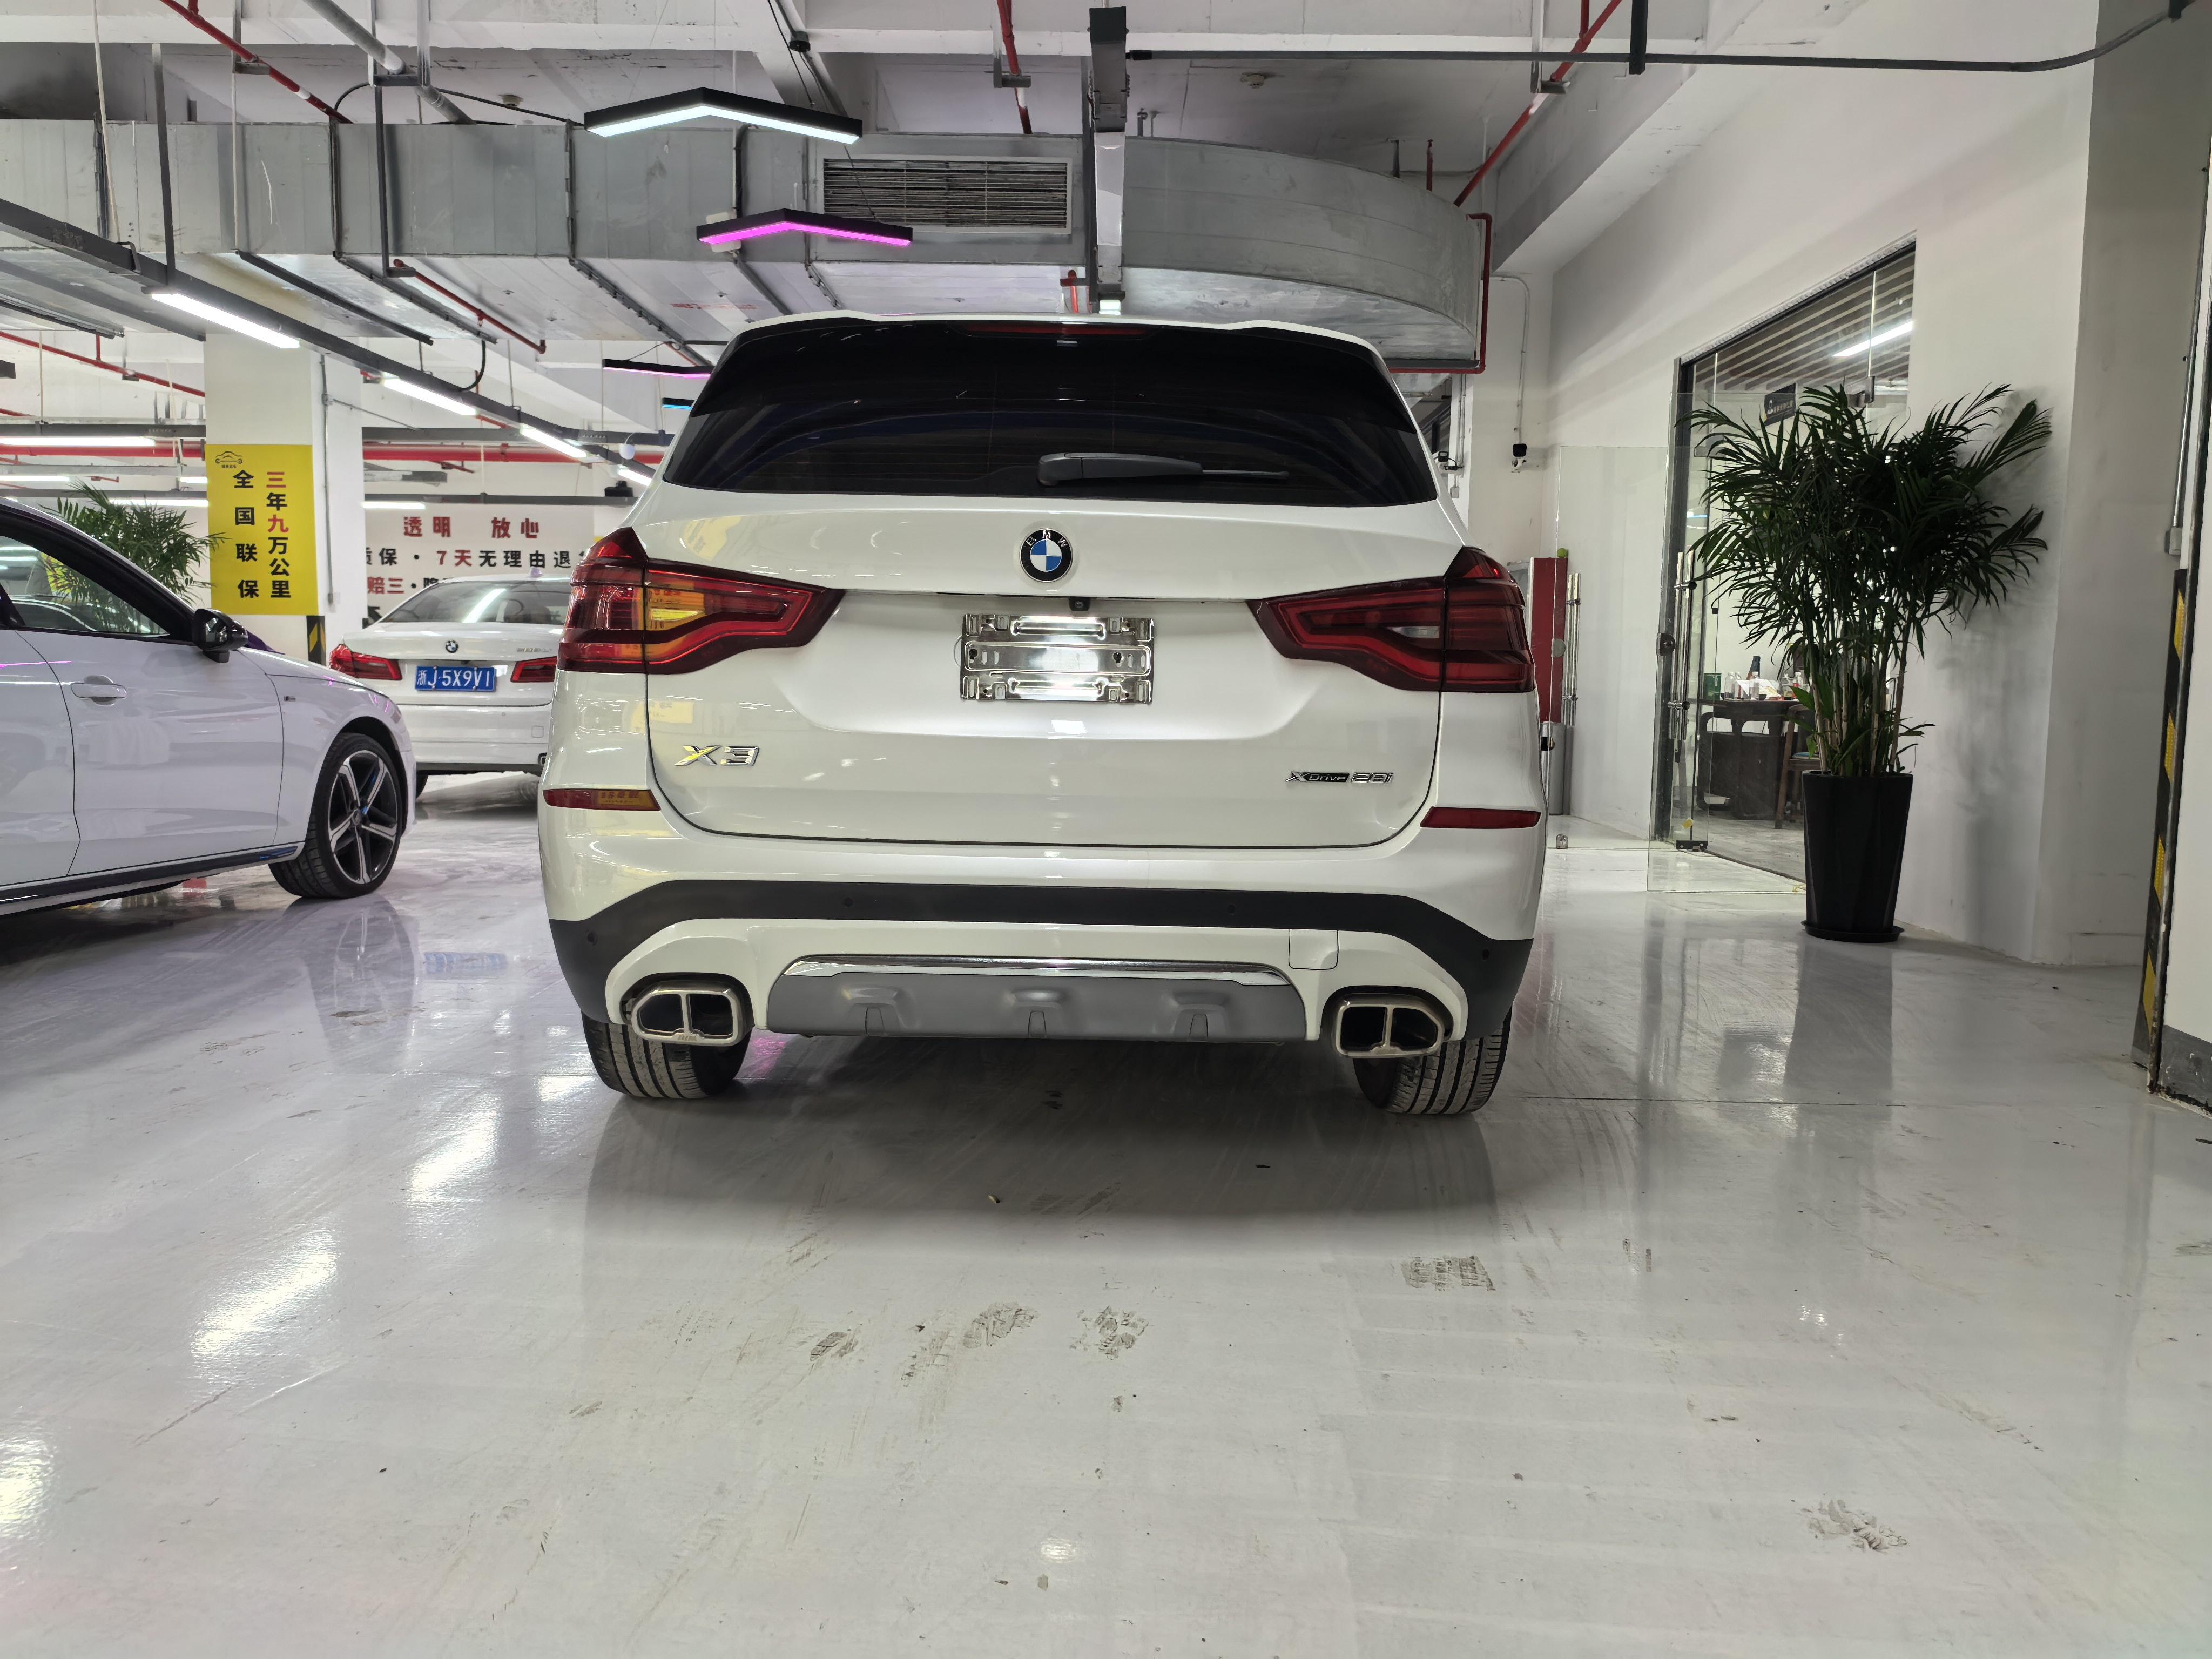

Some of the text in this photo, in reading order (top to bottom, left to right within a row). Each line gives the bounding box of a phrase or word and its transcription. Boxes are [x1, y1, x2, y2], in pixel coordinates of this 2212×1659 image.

[233, 470, 259, 598] 全国联保
[266, 471, 291, 598] 三年九万公里
[403, 516, 539, 538] 透明 放心
[674, 745, 759, 766] X3
